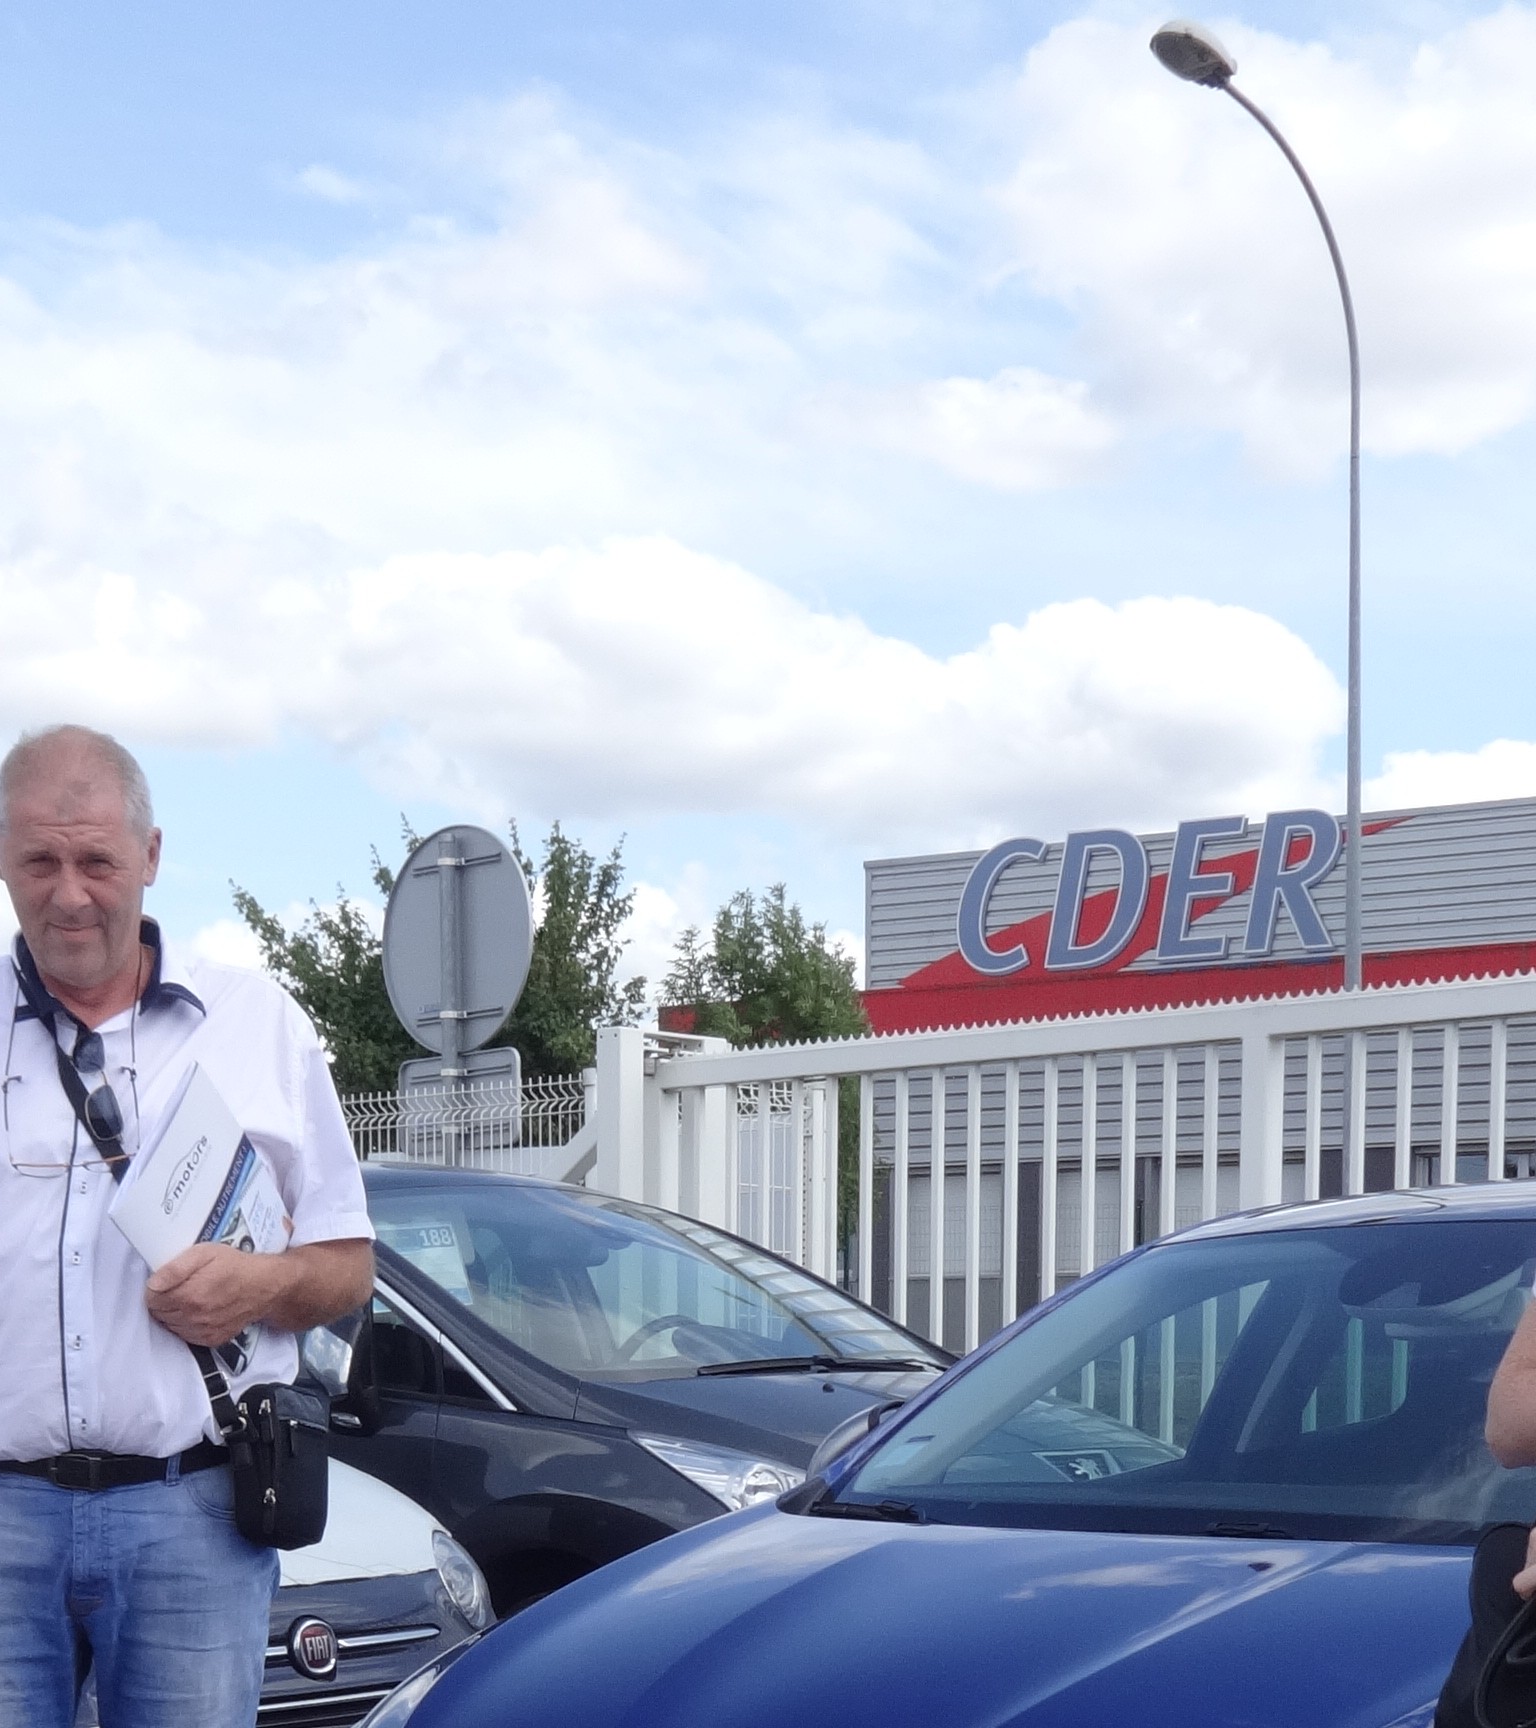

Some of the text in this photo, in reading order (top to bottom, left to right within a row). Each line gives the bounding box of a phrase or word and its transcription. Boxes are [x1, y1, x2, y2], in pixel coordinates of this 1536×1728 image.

[957, 808, 1340, 975] CDER
[419, 1228, 452, 1247] 188
[305, 1635, 329, 1661] FIAT
